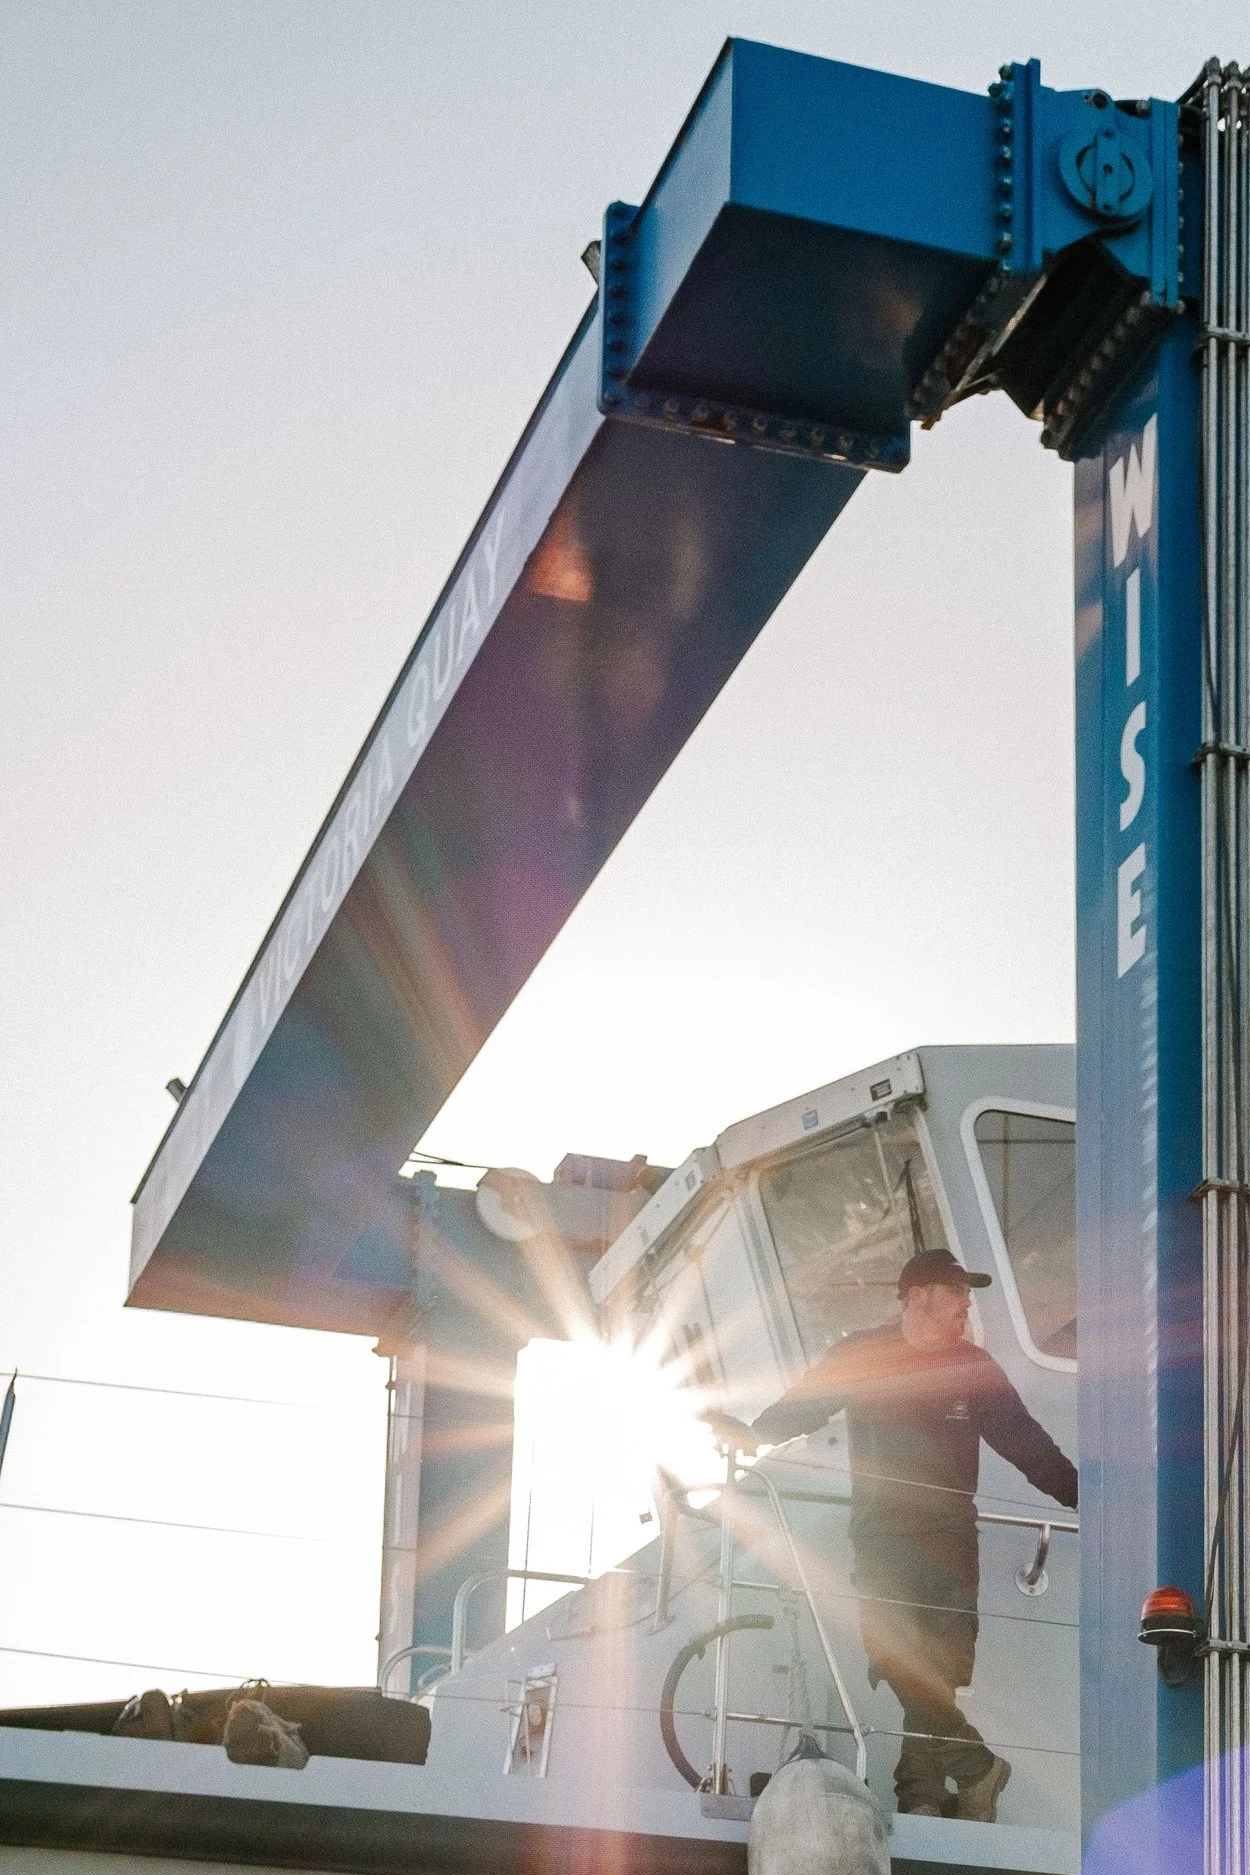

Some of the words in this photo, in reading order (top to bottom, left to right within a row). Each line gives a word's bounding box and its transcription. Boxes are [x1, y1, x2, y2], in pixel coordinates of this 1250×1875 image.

[253, 739, 395, 1027] VICTORIA
[406, 512, 508, 750] QUAY
[1108, 412, 1158, 980] WISE
